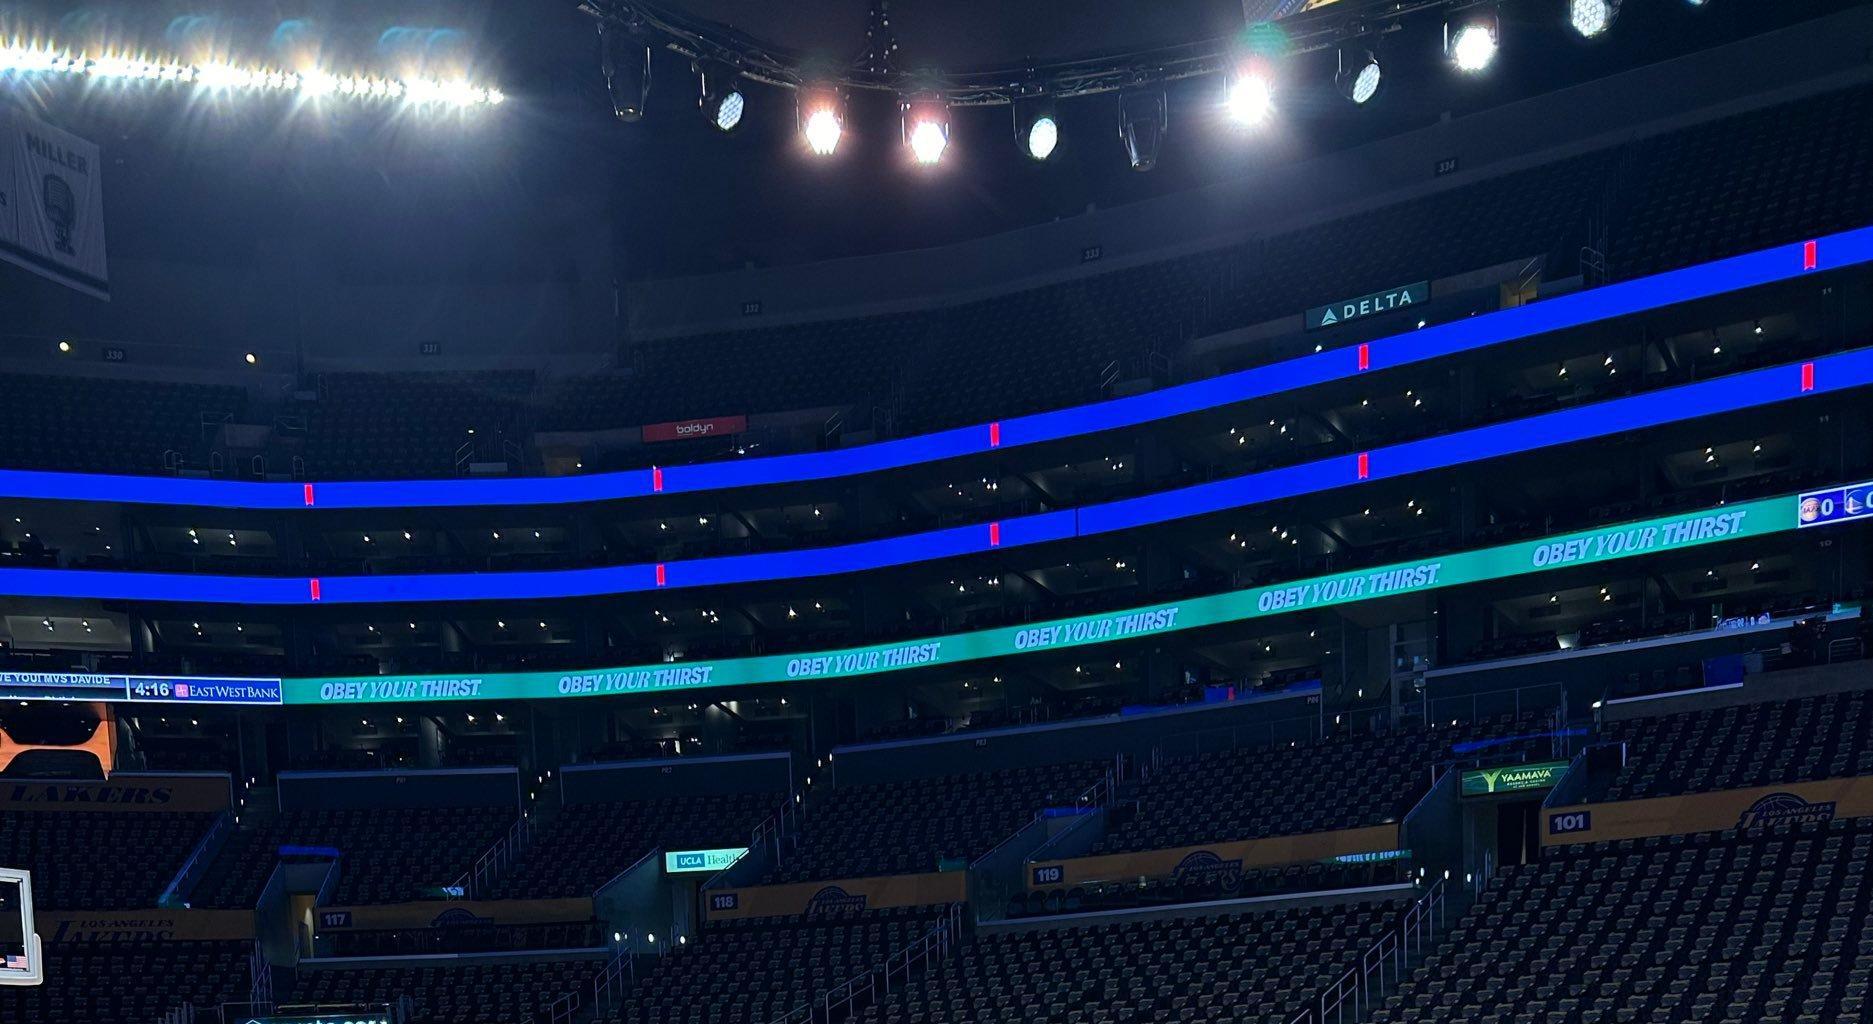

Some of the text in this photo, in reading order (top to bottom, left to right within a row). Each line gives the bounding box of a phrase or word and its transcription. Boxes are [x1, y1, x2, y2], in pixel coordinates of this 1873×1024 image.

[26, 132, 88, 176] MILLER
[1343, 290, 1412, 319] DELTA
[676, 423, 714, 434] boldyn
[1821, 498, 1834, 516] 0
[1533, 537, 1592, 567] OBEY
[1595, 526, 1659, 556] YOUR
[1258, 585, 1309, 612] OBEY
[1310, 576, 1365, 603] YOUR
[1014, 626, 1061, 650] OBEY
[1063, 619, 1112, 643] YOUR
[787, 657, 834, 678] OBEY
[834, 653, 880, 673] YOUR
[135, 683, 169, 697] 4:16
[320, 682, 366, 700] OBEY
[370, 680, 419, 698] YOUR
[558, 676, 602, 694] OBEY
[605, 672, 653, 691] YOUR
[10, 786, 173, 803] LAKERS
[1553, 815, 1585, 831] 101
[680, 856, 702, 865] UCLA
[1037, 867, 1060, 883] 119
[714, 895, 734, 908] 118
[325, 913, 345, 926] 117
